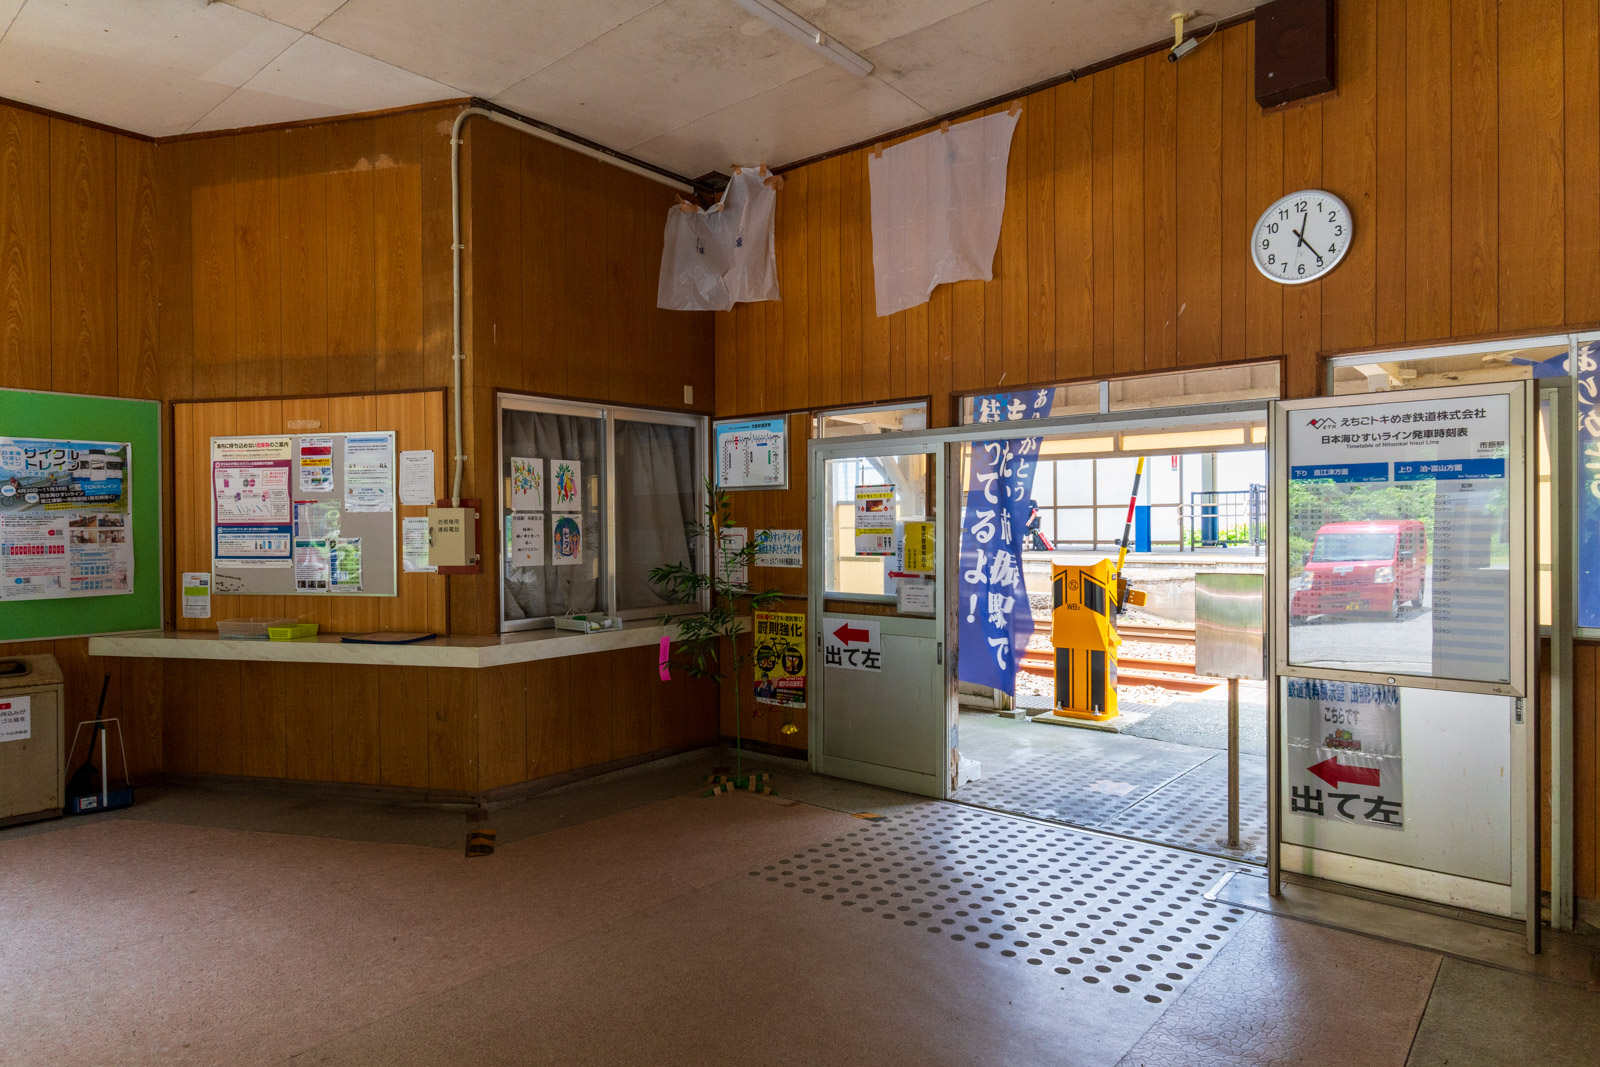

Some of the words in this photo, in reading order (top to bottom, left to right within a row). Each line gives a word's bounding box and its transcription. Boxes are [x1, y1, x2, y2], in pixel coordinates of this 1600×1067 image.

[1294, 201, 1308, 213] 12
[1317, 202, 1322, 212] 1
[1279, 209, 1289, 220] 11
[1328, 211, 1336, 222] 2
[1266, 222, 1279, 234] 10
[1334, 225, 1343, 236] 3
[1262, 239, 1269, 249] 9
[1328, 243, 1336, 254] 4
[1268, 254, 1275, 264] 8
[1316, 256, 1324, 267] 5
[1281, 263, 1288, 273] 7
[1298, 264, 1305, 274] 6
[1340, 408, 1487, 428] えちごトキめき鉄道株式会社
[1321, 427, 1468, 445] 日本海ひすいライン発車時刻表
[217, 441, 289, 449] 車内に持ち込めない危険物のご案内
[1479, 440, 1505, 449] 市振駅
[23, 448, 79, 460] サイクル
[25, 459, 80, 472] トレイン
[1398, 465, 1412, 474] 上り
[1419, 463, 1463, 473] 泊・富山方面
[1314, 468, 1349, 476] 直江津方面
[563, 530, 570, 550] 七夕
[757, 621, 803, 637] 罰則強化
[825, 645, 881, 669] 出て左
[1324, 706, 1360, 725] こちらです
[1291, 785, 1403, 828] 出て左
